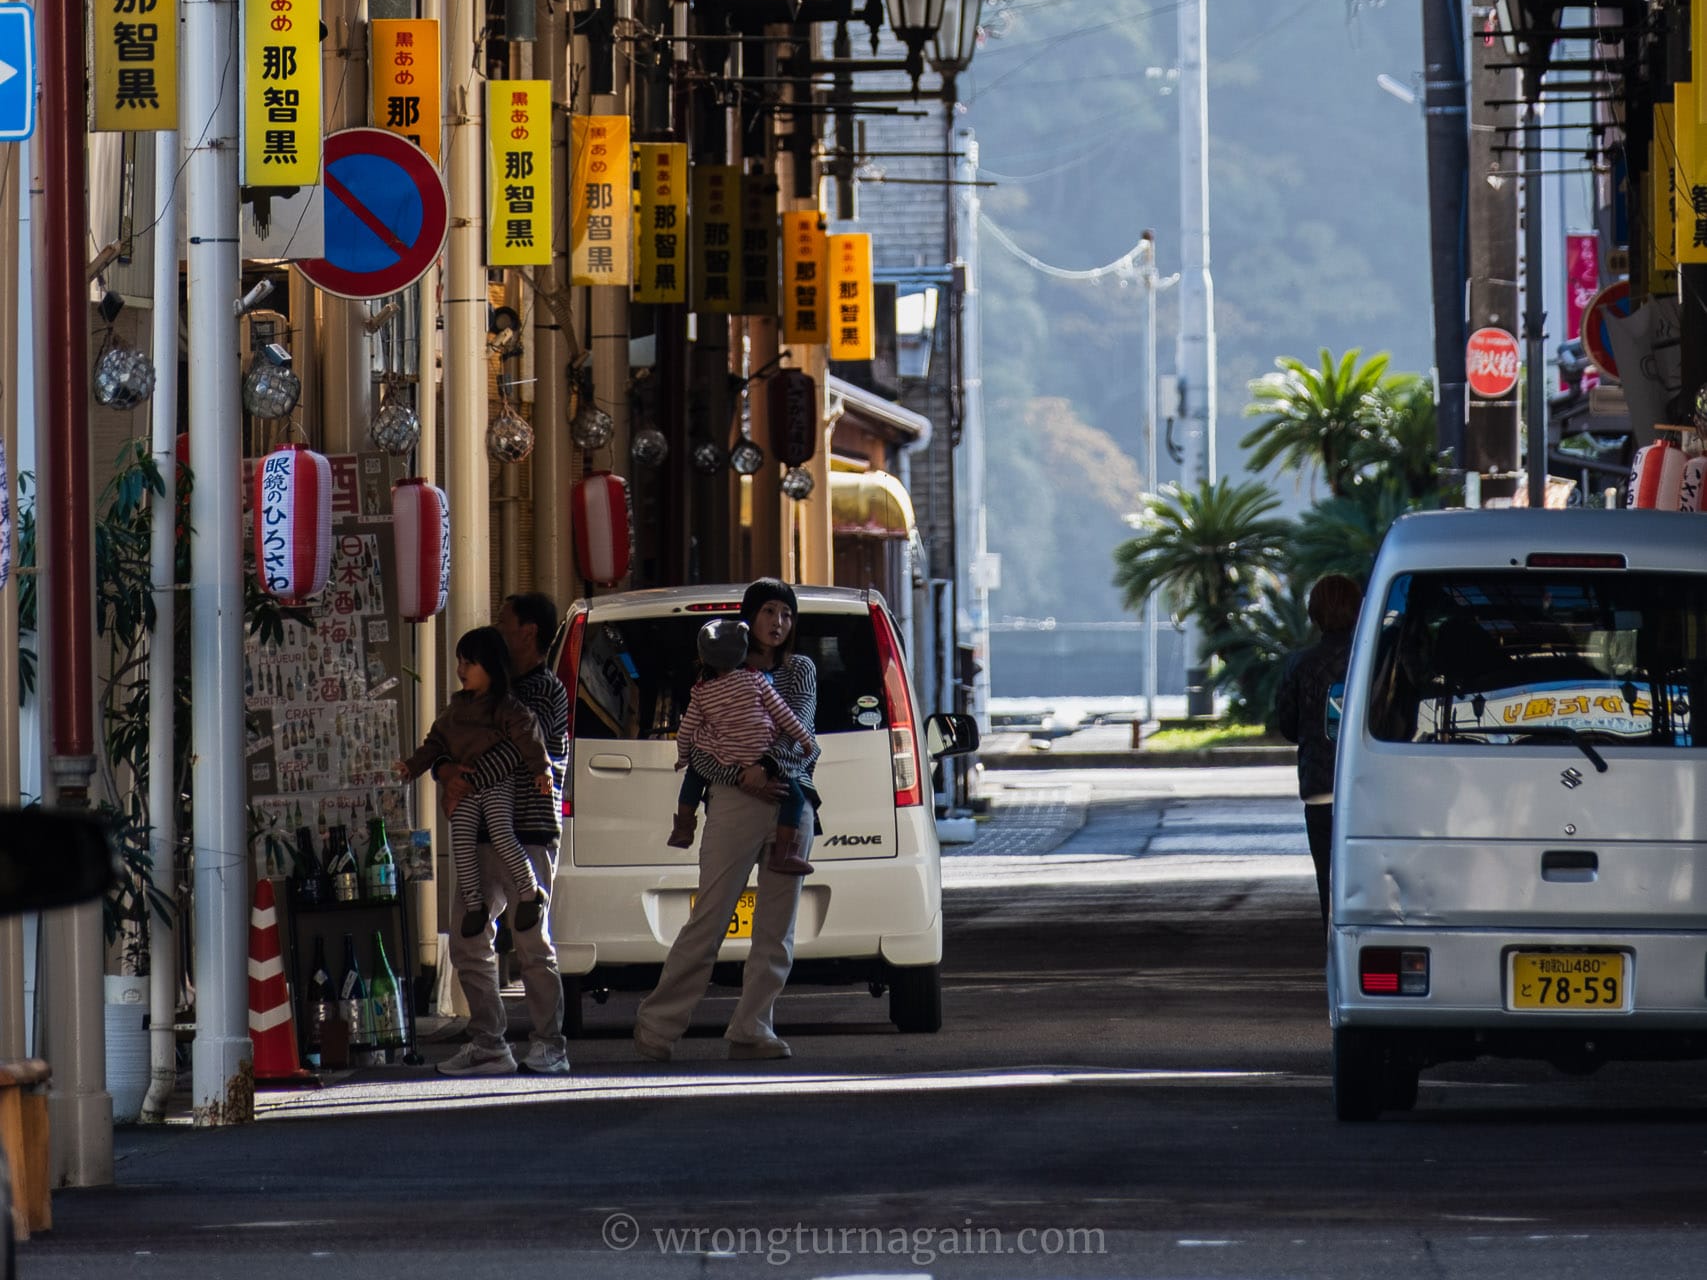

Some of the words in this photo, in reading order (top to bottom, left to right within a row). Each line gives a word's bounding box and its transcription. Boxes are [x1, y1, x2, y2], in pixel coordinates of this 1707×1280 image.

[394, 31, 414, 87] 黒あめ
[262, 45, 299, 166] 那智黒
[510, 91, 530, 141] 黒あめ
[504, 150, 535, 248] 那智黒
[584, 182, 614, 274] 那智黒
[653, 204, 678, 291] 那智黒
[1470, 349, 1517, 378] 消火栓
[262, 457, 291, 591] 眼鏡のひろさわ
[260, 653, 302, 666] LIQUEUR
[285, 708, 325, 720] CRAFT
[823, 834, 882, 847] MOVE
[1537, 976, 1617, 1004] 78-59
[1539, 959, 1600, 974] 和歌山480
